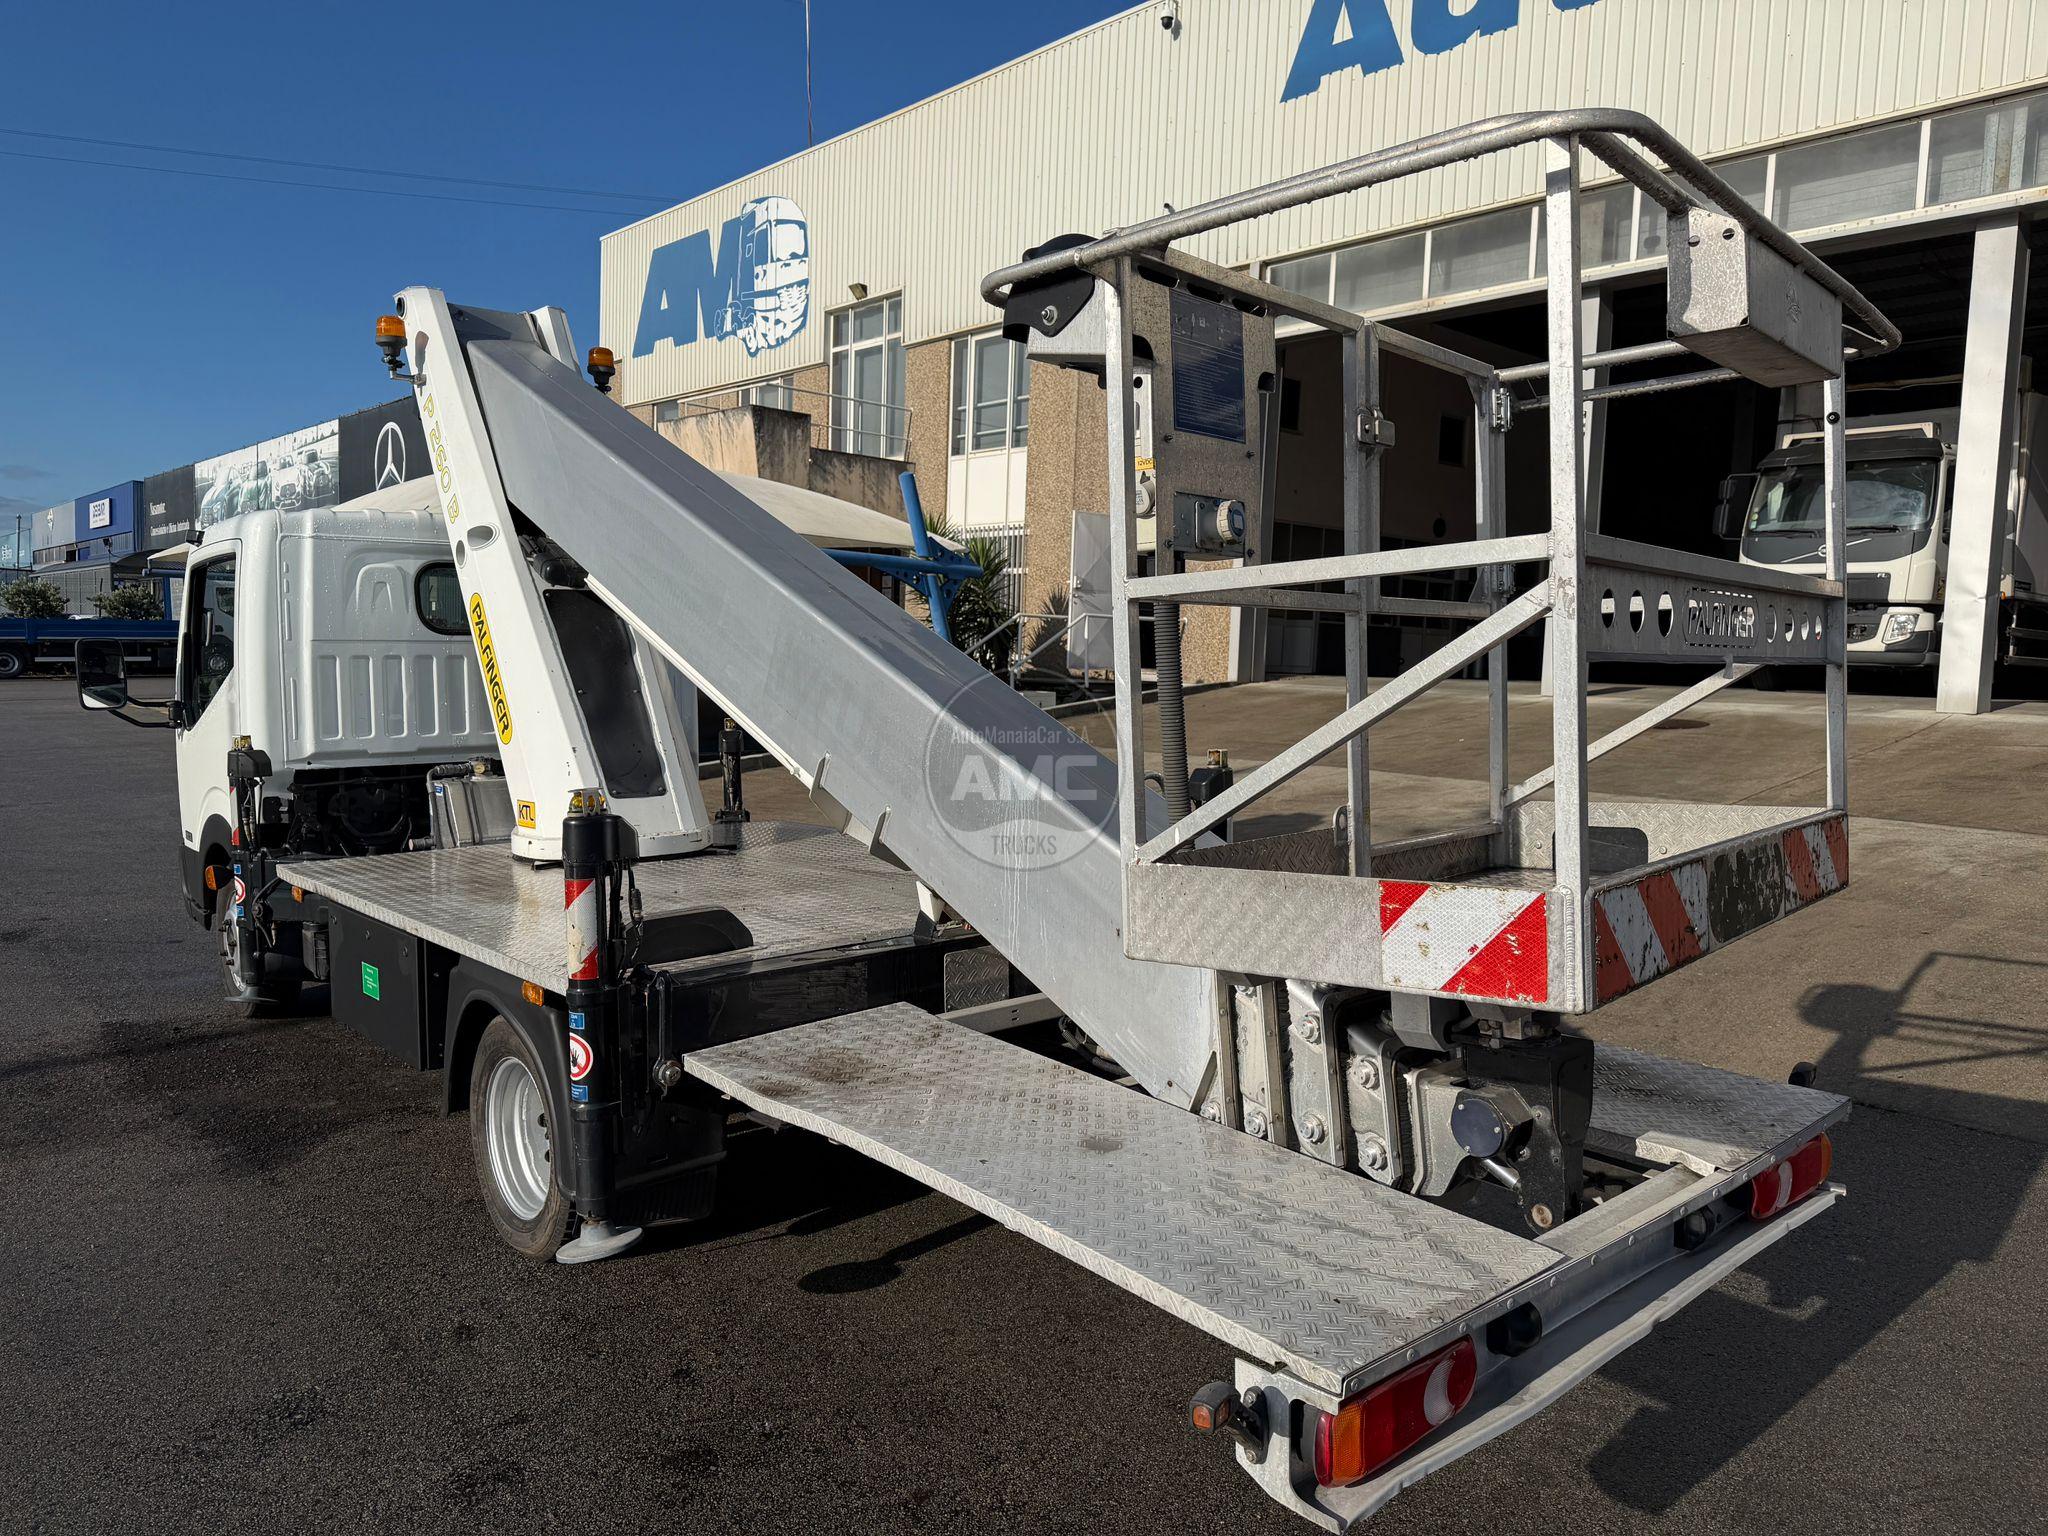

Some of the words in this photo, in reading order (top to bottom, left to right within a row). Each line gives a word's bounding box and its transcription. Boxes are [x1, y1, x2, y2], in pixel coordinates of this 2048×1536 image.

[429, 420, 452, 493] 260
[447, 493, 459, 524] B
[1688, 599, 1755, 638] PALFINGER
[472, 601, 509, 735] PALFINGER
[518, 803, 535, 822] KTL
[1467, 944, 1480, 956] 3M
